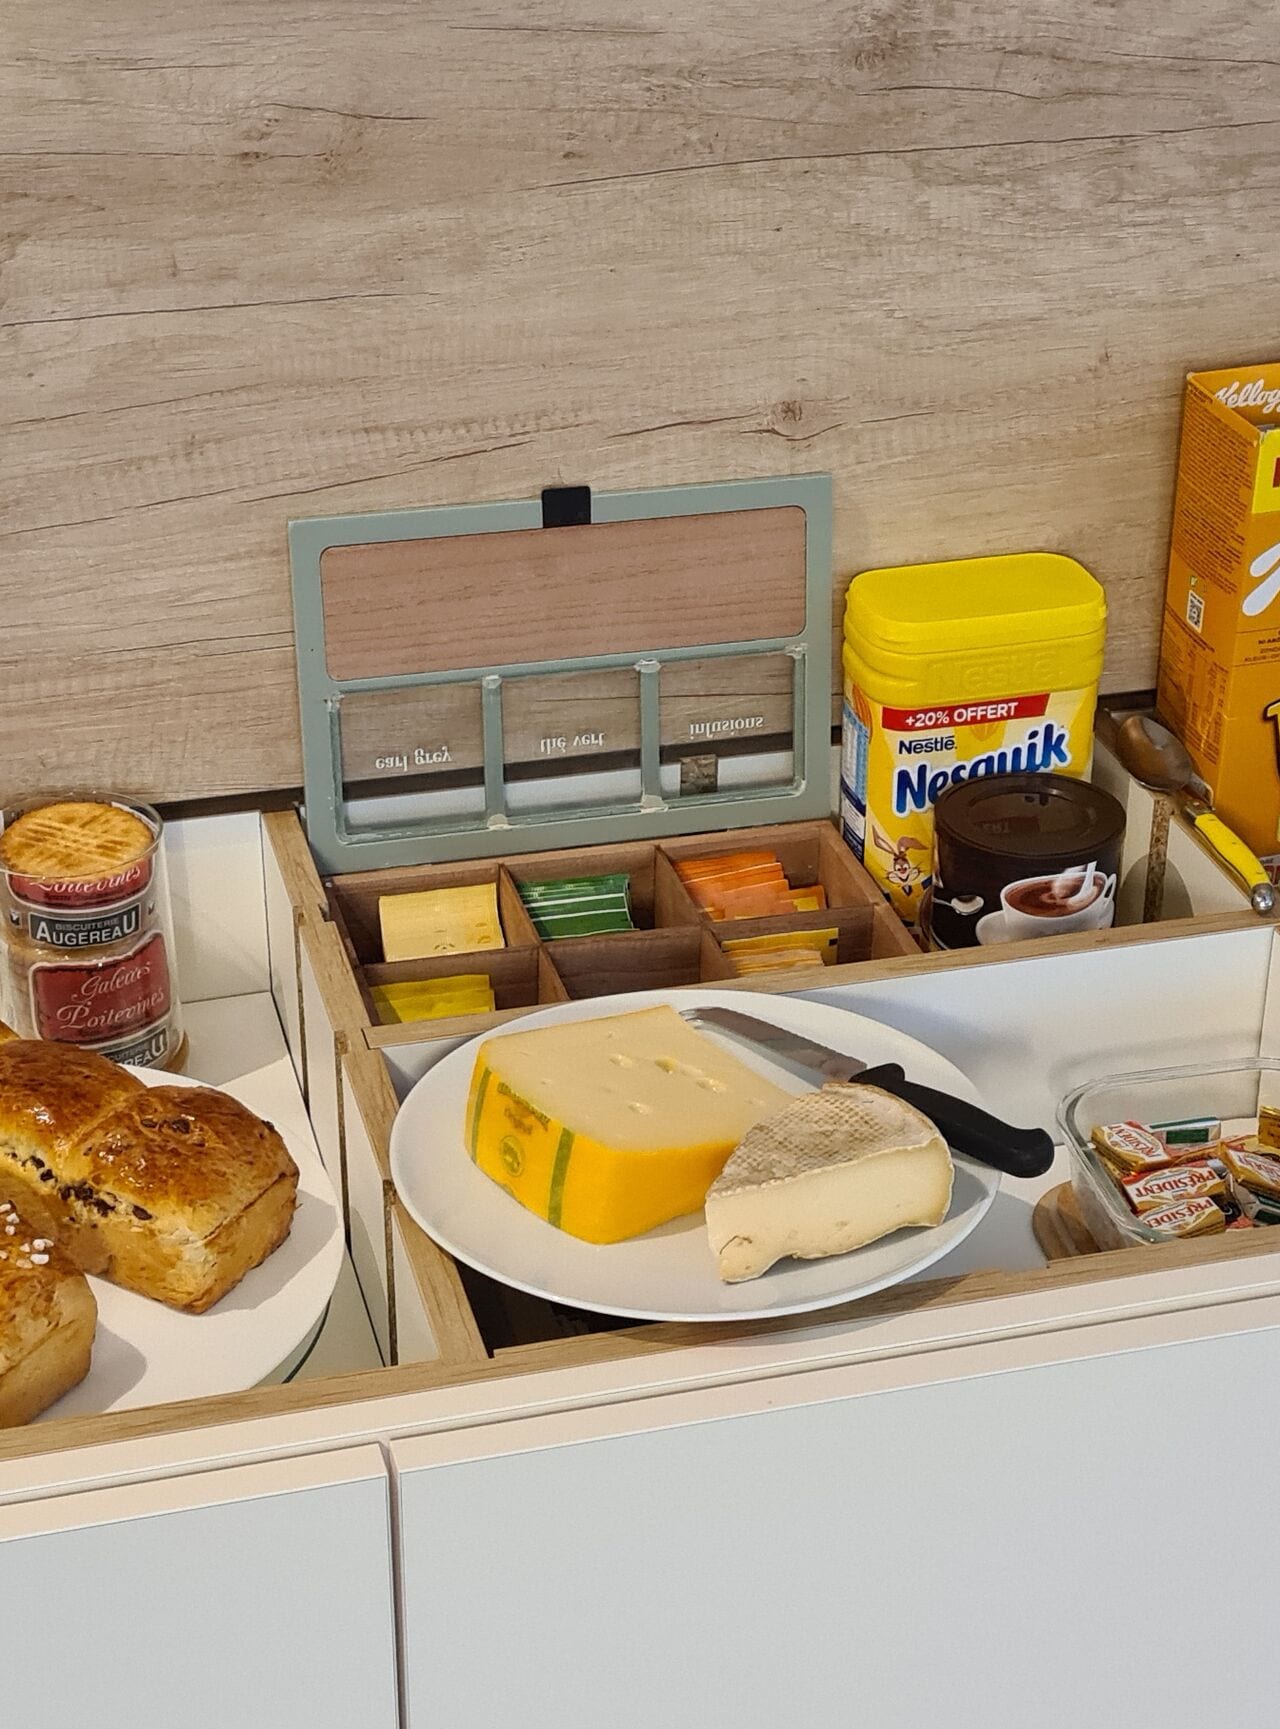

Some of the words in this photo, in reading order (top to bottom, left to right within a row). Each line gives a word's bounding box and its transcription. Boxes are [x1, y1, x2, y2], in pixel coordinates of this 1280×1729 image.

[905, 709, 950, 728] +20%
[953, 702, 1019, 722] OFFERT
[35, 910, 137, 946] AUGEREAU
[56, 986, 166, 1031] Poitevines
[1135, 1170, 1217, 1198] PRÉSIDENT
